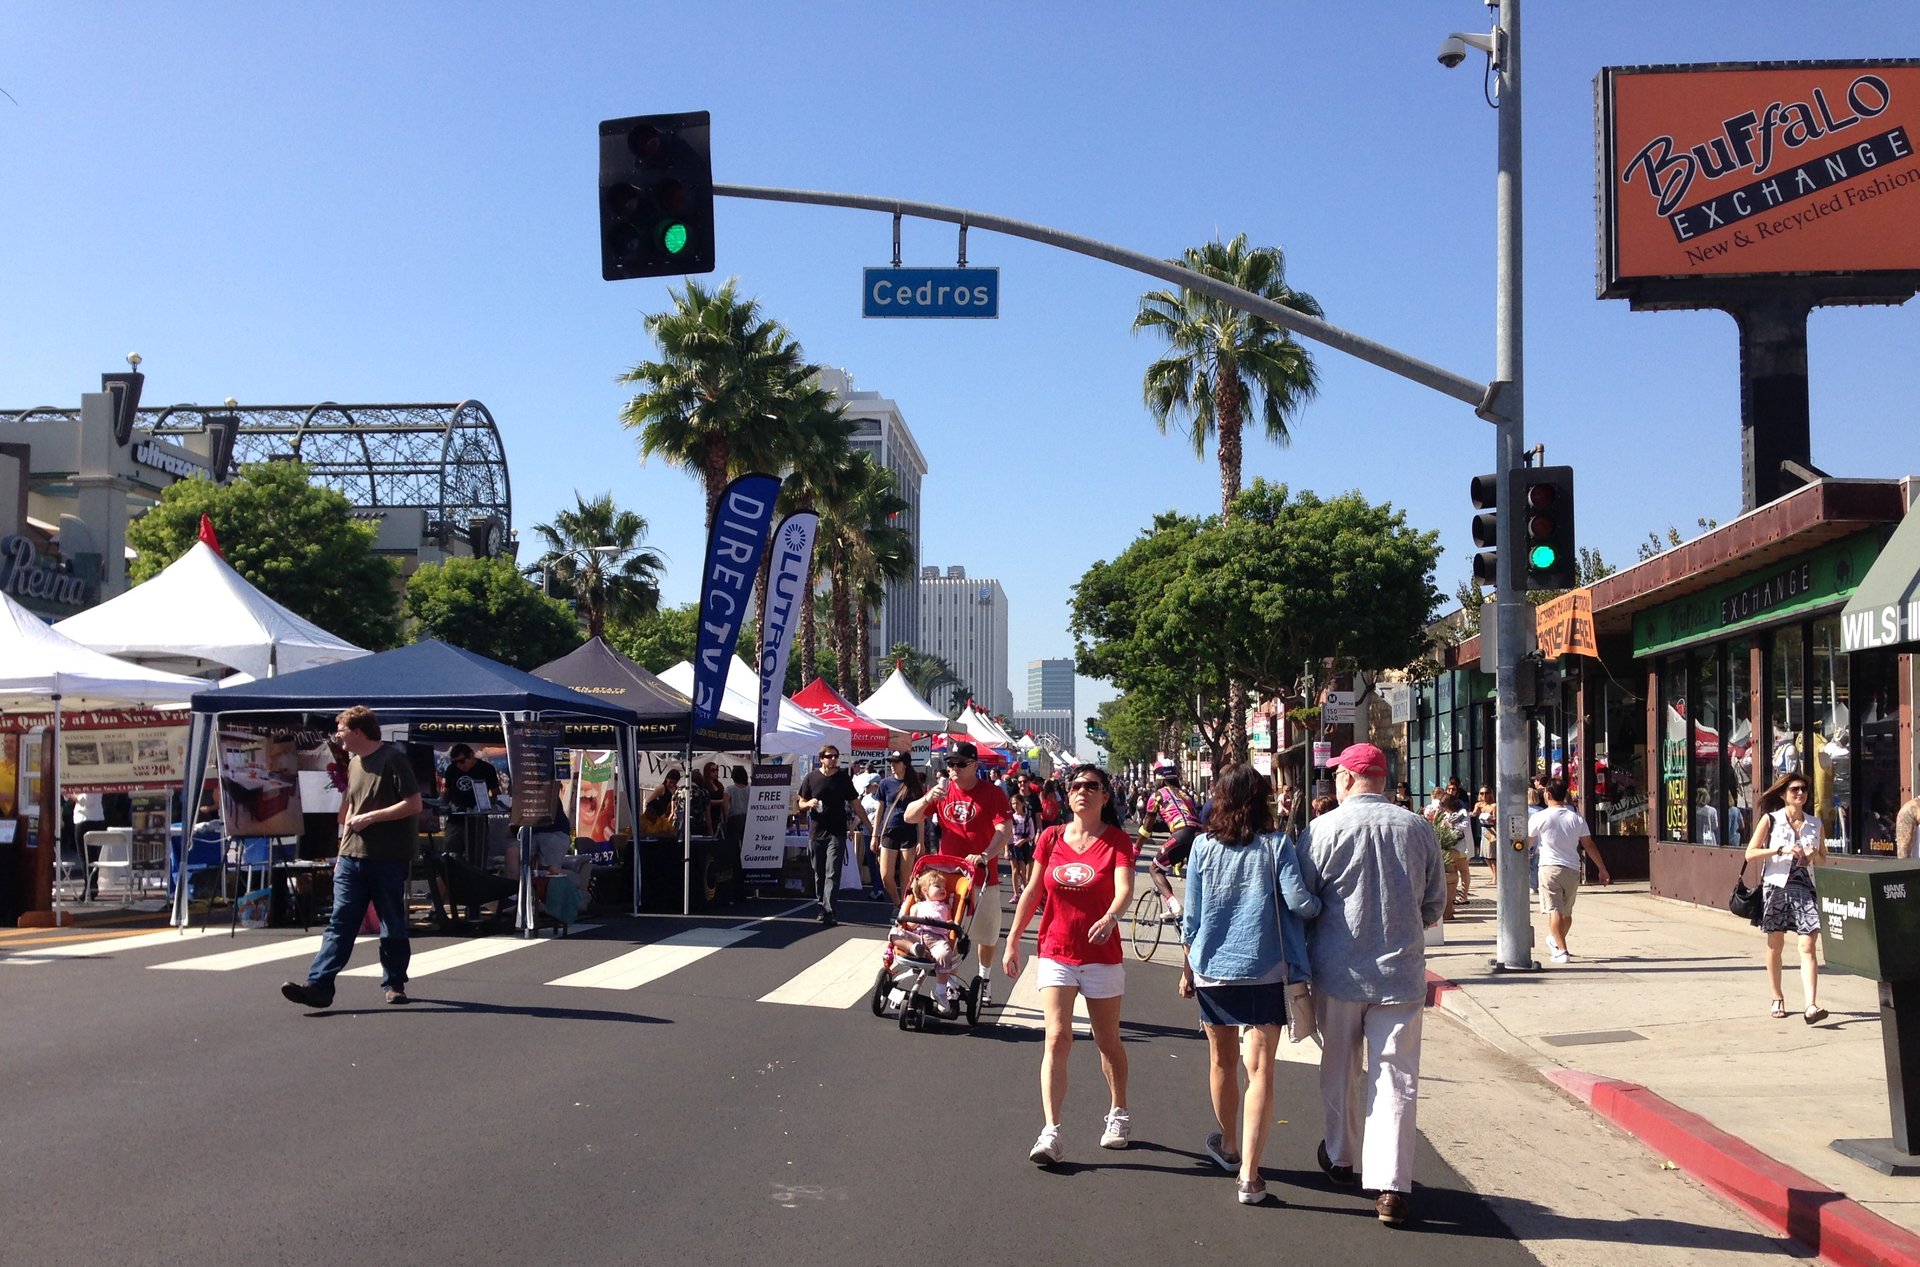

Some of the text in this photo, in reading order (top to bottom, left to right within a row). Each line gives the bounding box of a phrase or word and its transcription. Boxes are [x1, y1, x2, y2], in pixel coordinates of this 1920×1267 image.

[1674, 130, 1909, 240] EXCHANGE
[1685, 168, 1920, 267] New & Recycled Fashion
[873, 279, 990, 306] Cedros
[6, 535, 86, 605] Reina
[702, 491, 765, 673] DIRECTV
[1721, 564, 1810, 625] EXCHANGE
[761, 550, 802, 707] LUTRON
[0, 708, 191, 730] ir Qualiy at Van Nuys Pric
[419, 722, 474, 732] GOLDEN
[478, 723, 503, 733] STA
[564, 723, 678, 736] ENTERTMENT
[851, 749, 885, 758] EOWNERS
[152, 763, 176, 777] 20%
[758, 790, 782, 801] FREE
[1669, 779, 1686, 800] NEW
[756, 814, 775, 822] TODAY
[1666, 805, 1688, 829] USED
[1824, 838, 1846, 848] omen's
[1869, 838, 1894, 851] fashion
[1822, 896, 1867, 920] Working World
[1828, 914, 1843, 928] JOBS
